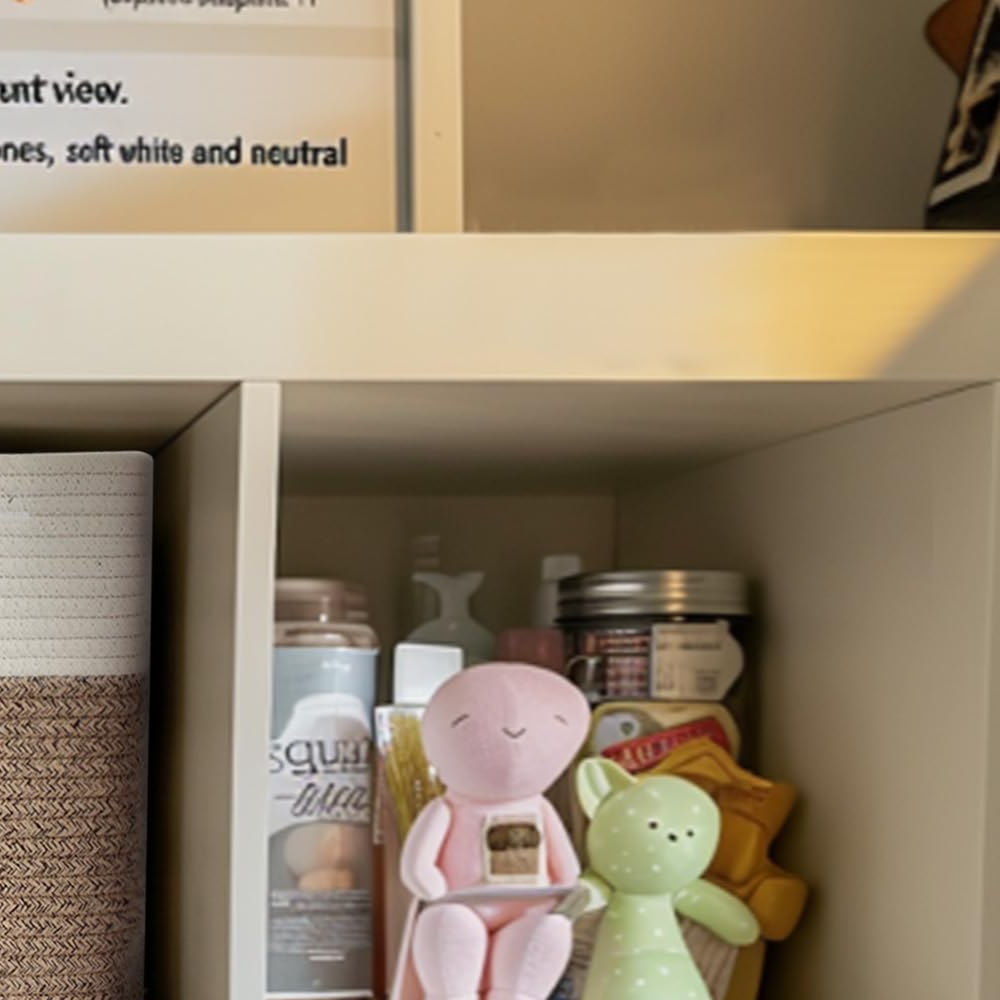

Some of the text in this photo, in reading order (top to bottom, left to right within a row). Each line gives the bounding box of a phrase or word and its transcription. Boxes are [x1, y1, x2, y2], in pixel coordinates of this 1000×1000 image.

[65, 134, 114, 164] soft
[191, 136, 243, 165] and
[250, 137, 349, 168] neutral
